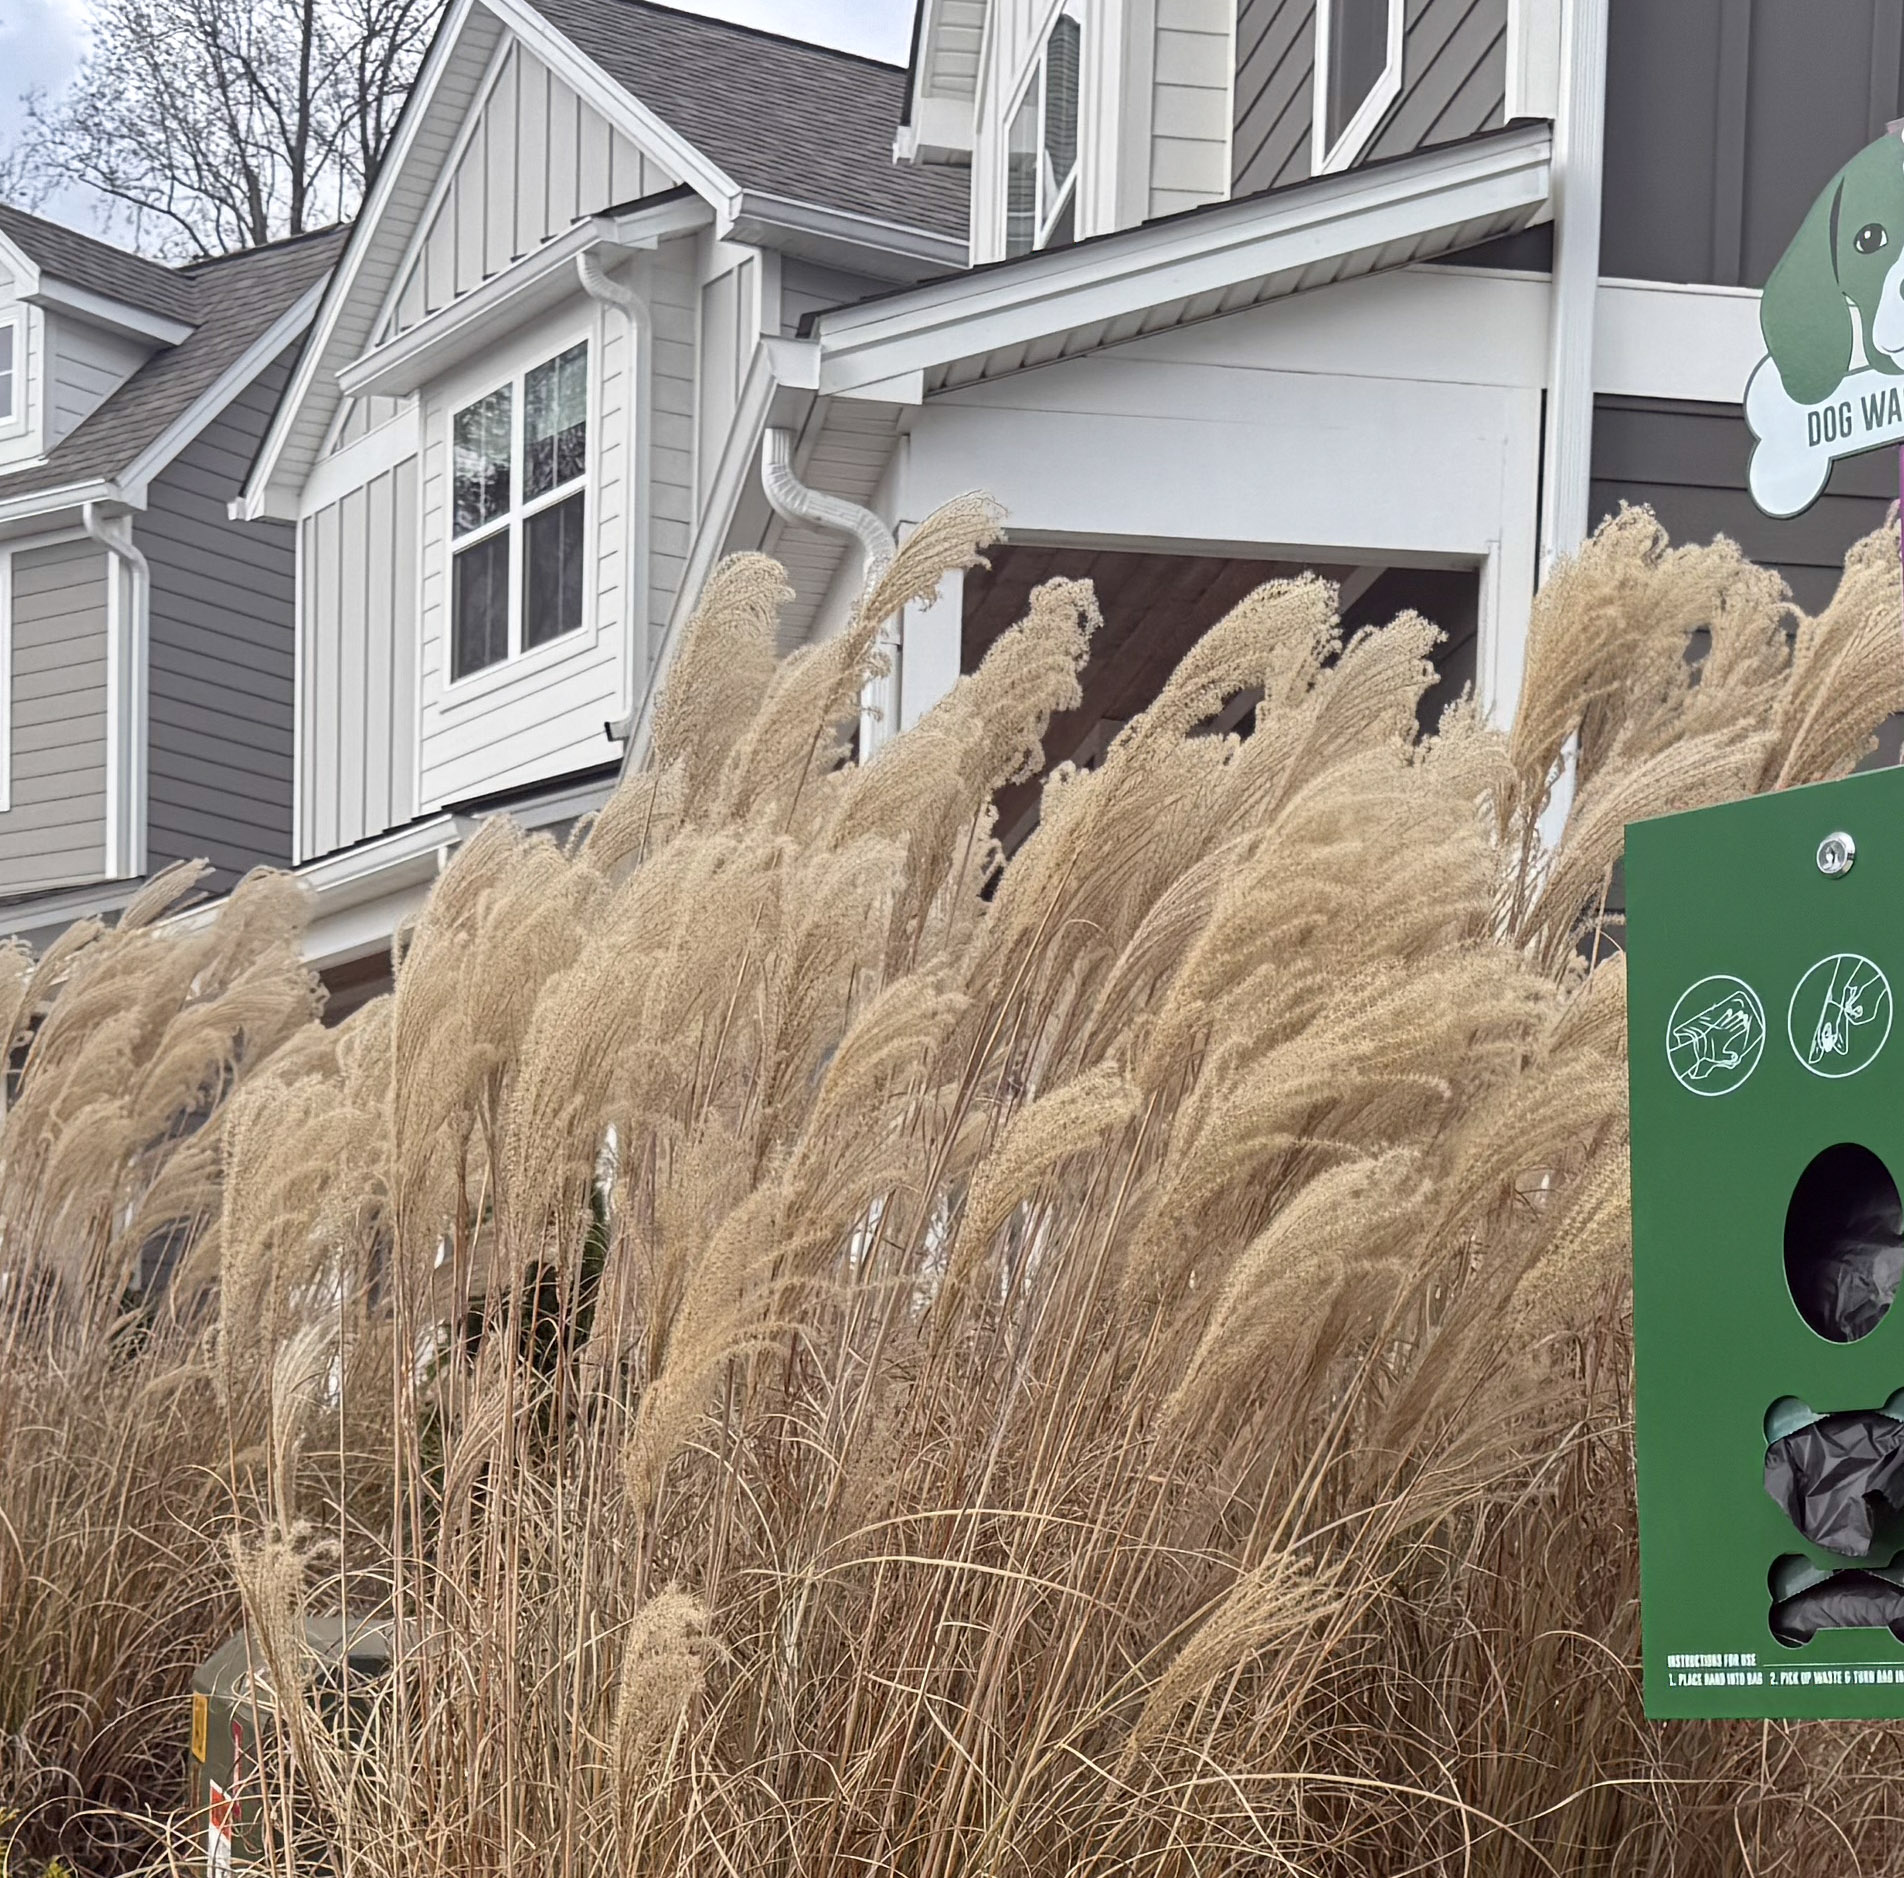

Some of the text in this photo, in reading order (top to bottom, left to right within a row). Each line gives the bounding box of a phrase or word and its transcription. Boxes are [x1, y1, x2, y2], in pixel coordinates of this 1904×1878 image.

[1807, 401, 1853, 447] DOG
[1740, 1653, 1756, 1667] USE
[1678, 1673, 1703, 1686] PLACE
[1813, 1670, 1843, 1685] WASTE
